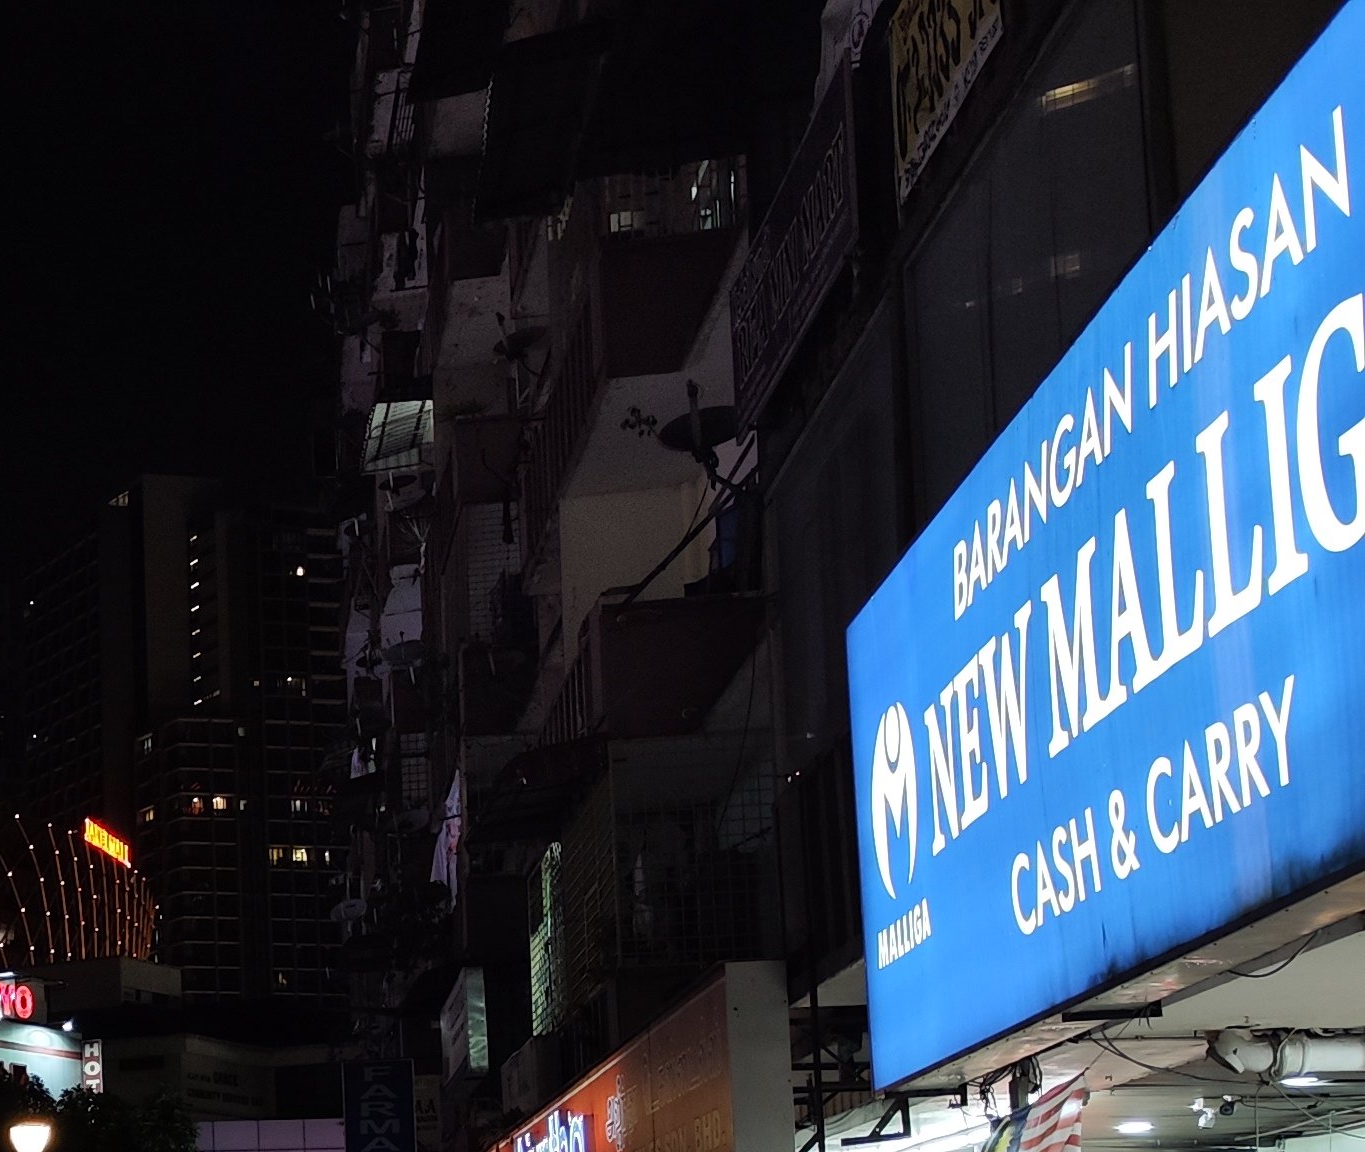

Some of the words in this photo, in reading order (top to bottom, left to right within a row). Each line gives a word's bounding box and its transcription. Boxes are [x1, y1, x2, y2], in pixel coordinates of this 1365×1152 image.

[953, 341, 1132, 621] BARANGAN
[1148, 105, 1351, 409] HIASAN
[923, 599, 1032, 857] NEW
[1011, 807, 1102, 935] CASH
[1108, 789, 1141, 880] &
[1146, 674, 1295, 854] CARRY
[878, 898, 932, 969] MALLIGA
[83, 1041, 101, 1095] HOT
